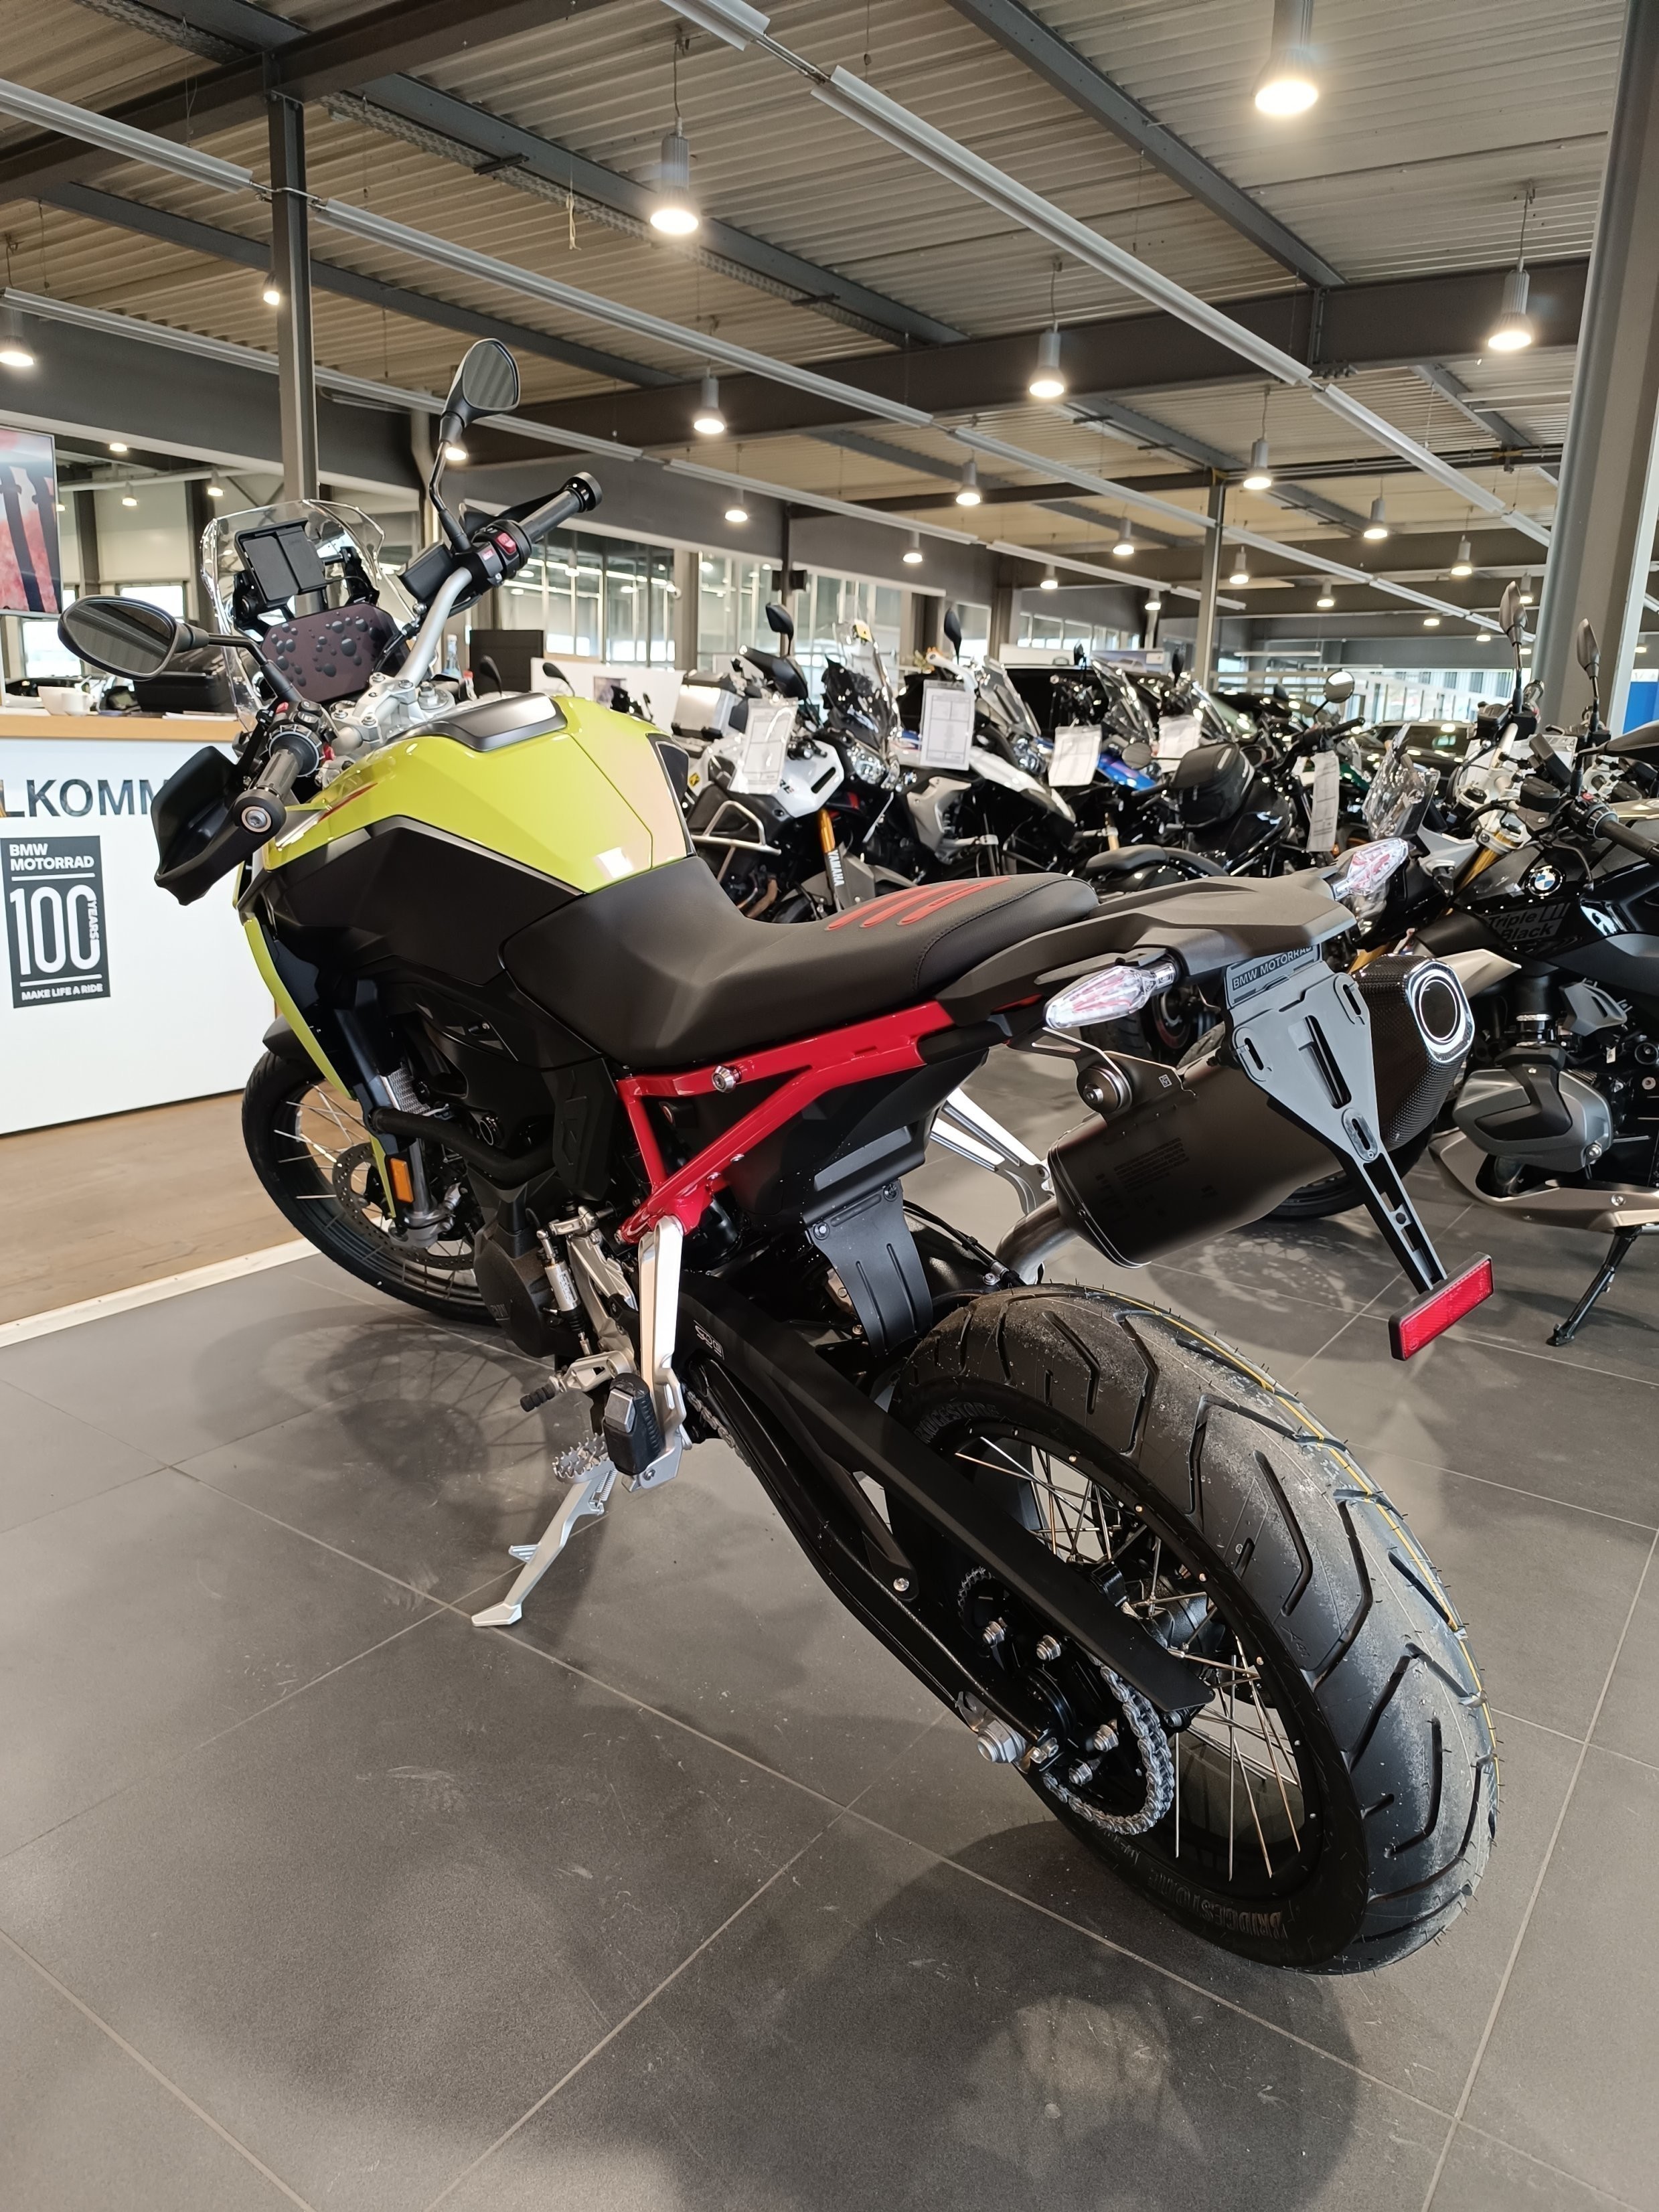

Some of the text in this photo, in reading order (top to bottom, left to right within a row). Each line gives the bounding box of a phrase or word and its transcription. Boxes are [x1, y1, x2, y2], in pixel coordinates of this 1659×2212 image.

[9, 843, 48, 856] BMW
[10, 856, 94, 871] MOTORRAD
[828, 849, 845, 886] YAMAHA
[88, 900, 99, 940] YEARS
[1488, 910, 1538, 928] Triple
[9, 884, 100, 975] 100
[1501, 923, 1554, 941] Black
[1233, 969, 1257, 989] BMW
[21, 983, 103, 1000] MAKE LIFE A RIDE
